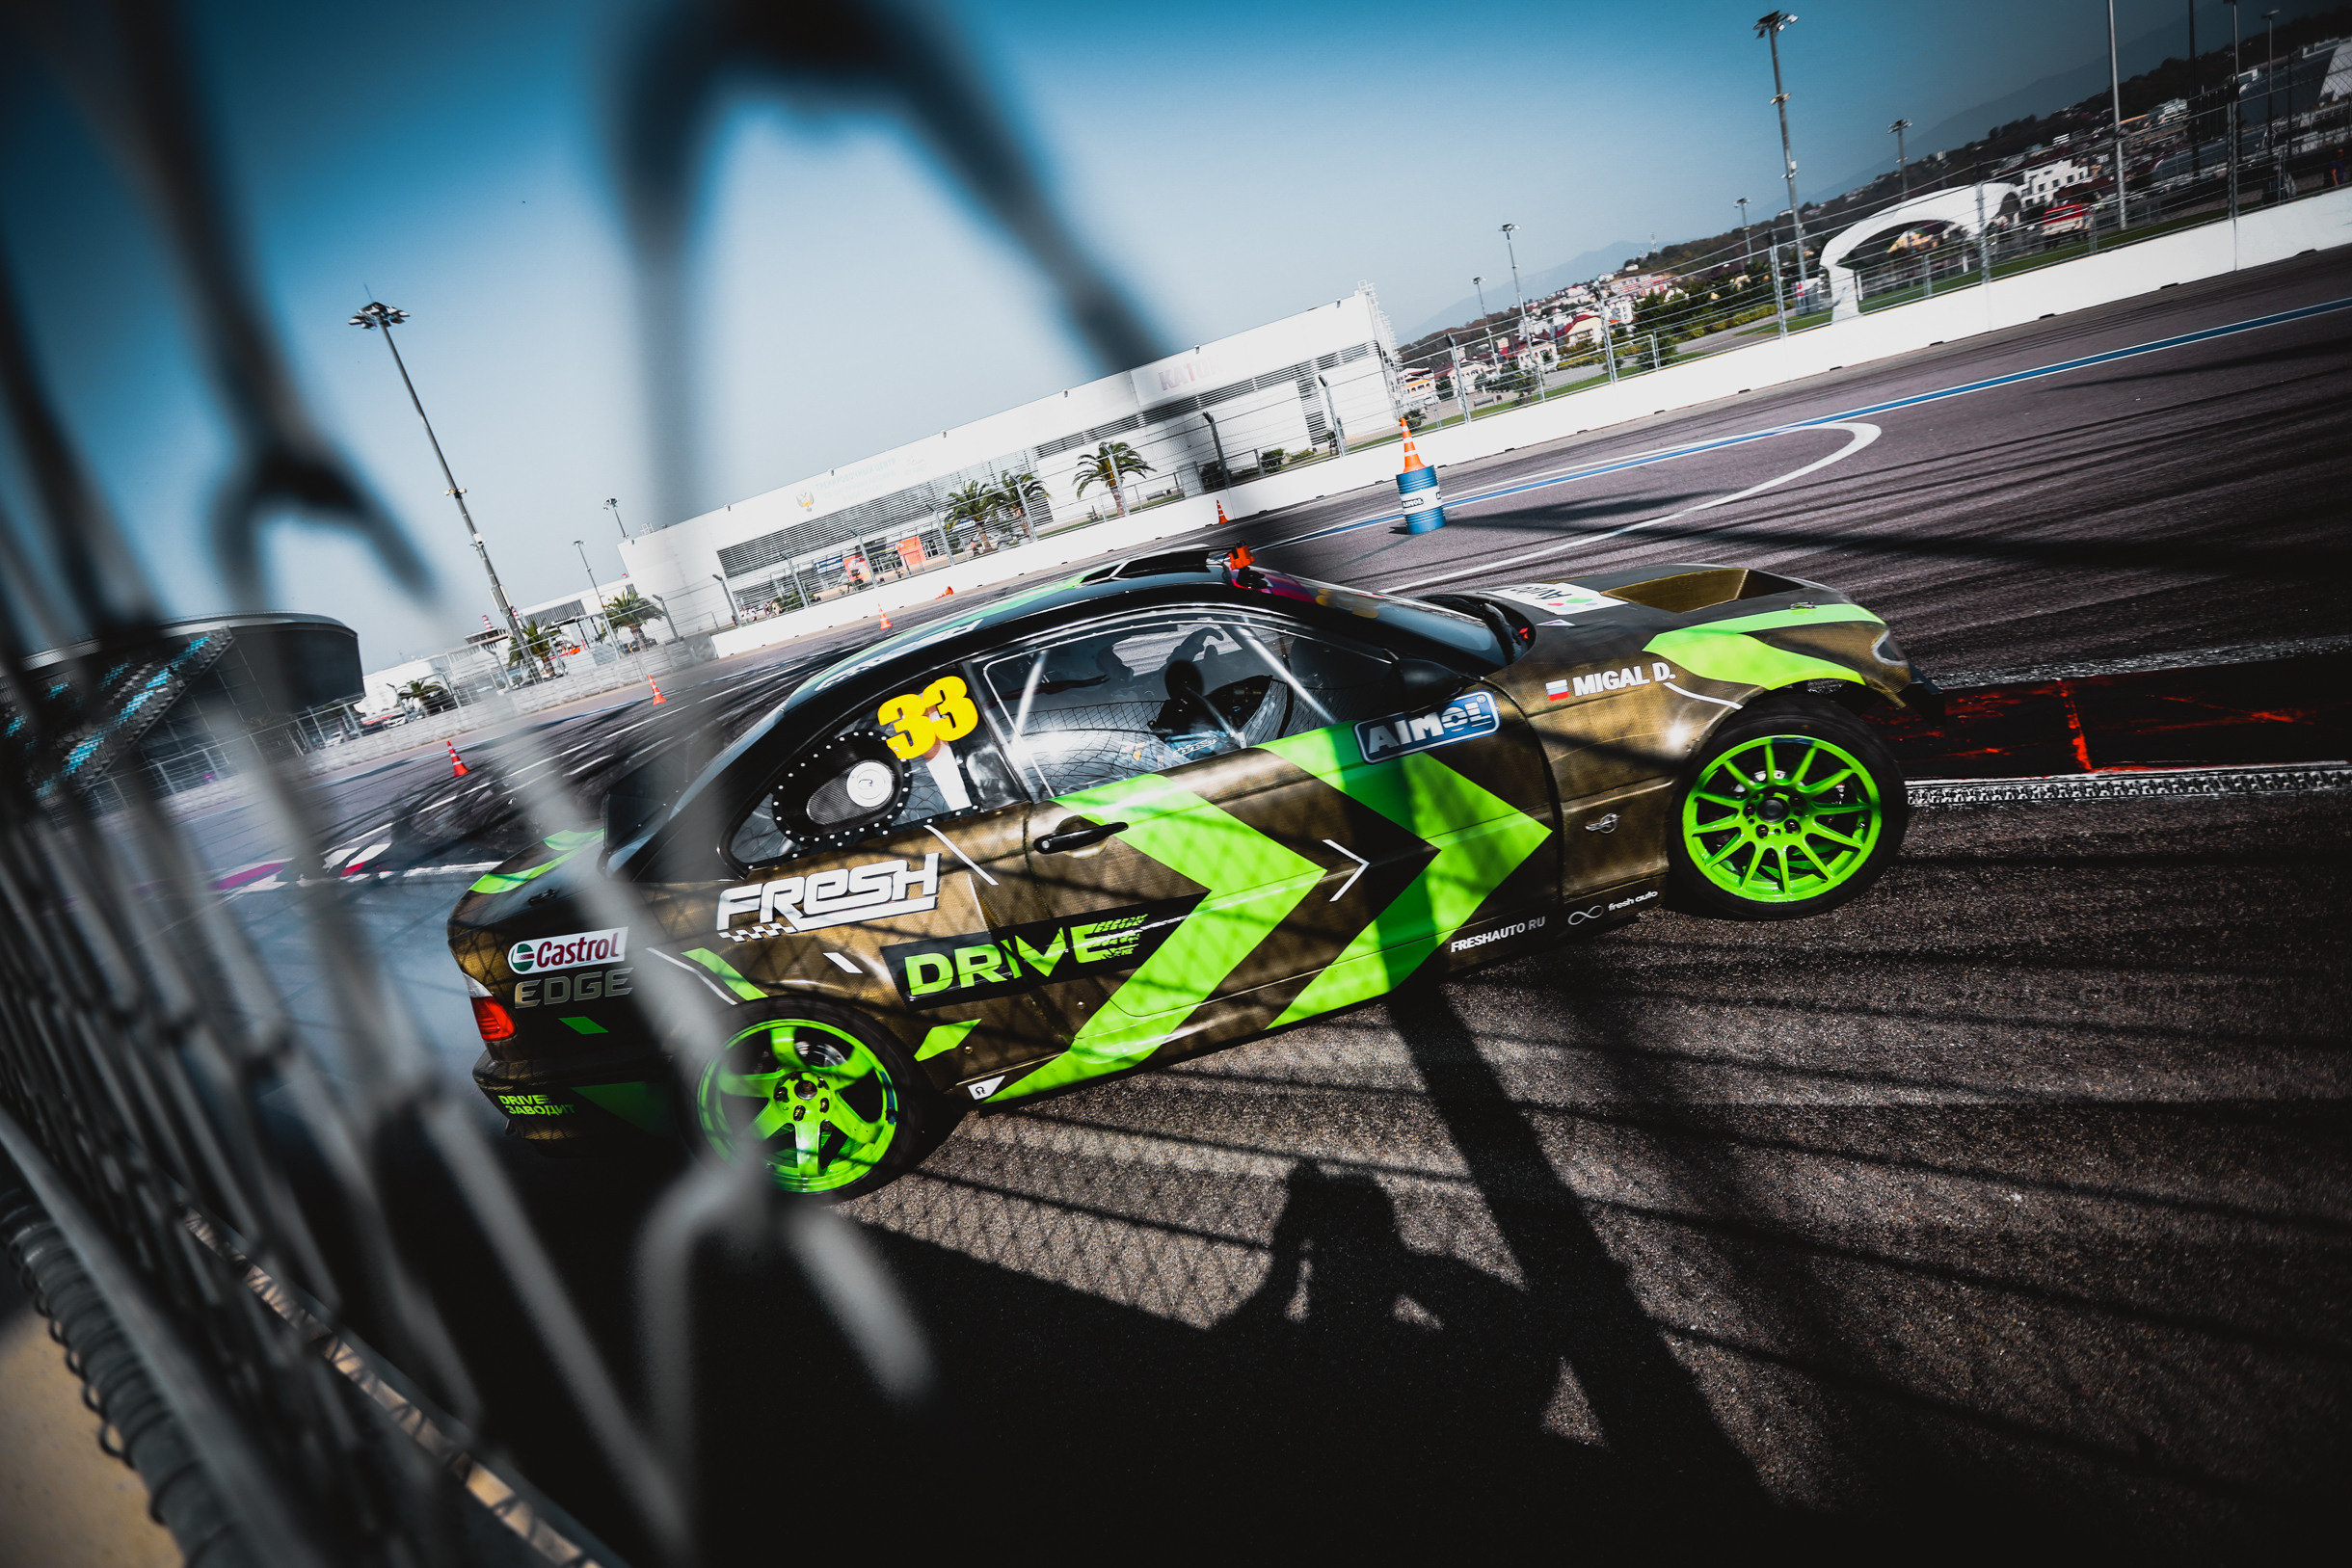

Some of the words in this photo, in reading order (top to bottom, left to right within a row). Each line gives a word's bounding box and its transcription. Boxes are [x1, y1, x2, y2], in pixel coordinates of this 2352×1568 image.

[1572, 665, 1650, 697] MIGAL
[1651, 661, 1676, 682] D.
[877, 676, 978, 759] 33
[1368, 701, 1493, 755] AIMOL
[1608, 898, 1635, 912] fresh
[1636, 890, 1659, 903] auto
[536, 931, 620, 969] Castrol
[904, 914, 1148, 997] DRIVE
[515, 967, 634, 1009] EDGE
[498, 1094, 550, 1105] DRIVE
[505, 1104, 575, 1116] ЗАВОДИТ
